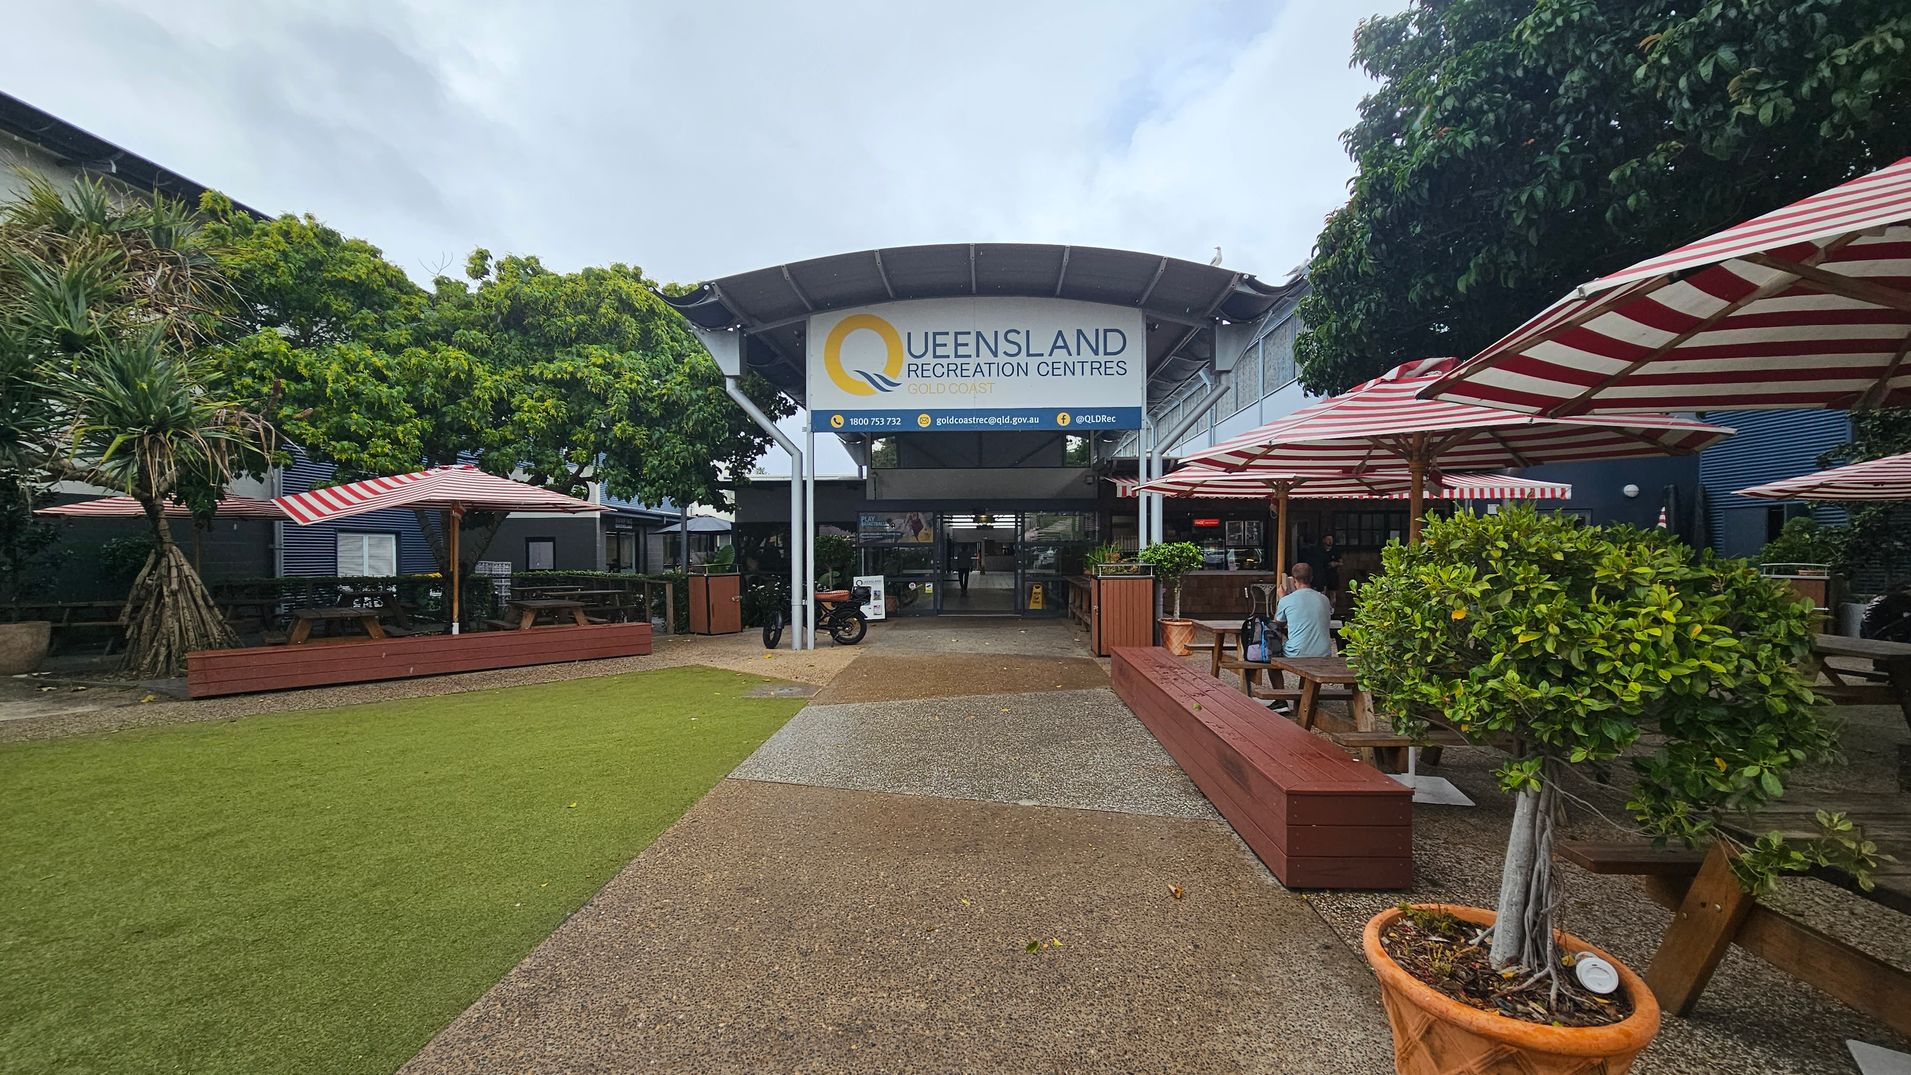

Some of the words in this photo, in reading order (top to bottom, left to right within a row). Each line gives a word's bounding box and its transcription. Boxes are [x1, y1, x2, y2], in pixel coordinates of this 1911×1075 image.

[824, 314, 1127, 397] QUEENSLAND
[908, 362, 1028, 378] RECREATION
[1037, 361, 1127, 377] CENTRES
[908, 383, 946, 394] GOLD
[949, 382, 995, 394] COAST
[850, 418, 868, 426] 1800
[869, 418, 885, 426] 753
[886, 417, 901, 426] 732
[936, 415, 1039, 427] goldcoastrec@qld.gov.au
[1076, 414, 1116, 425] @QLDRec
